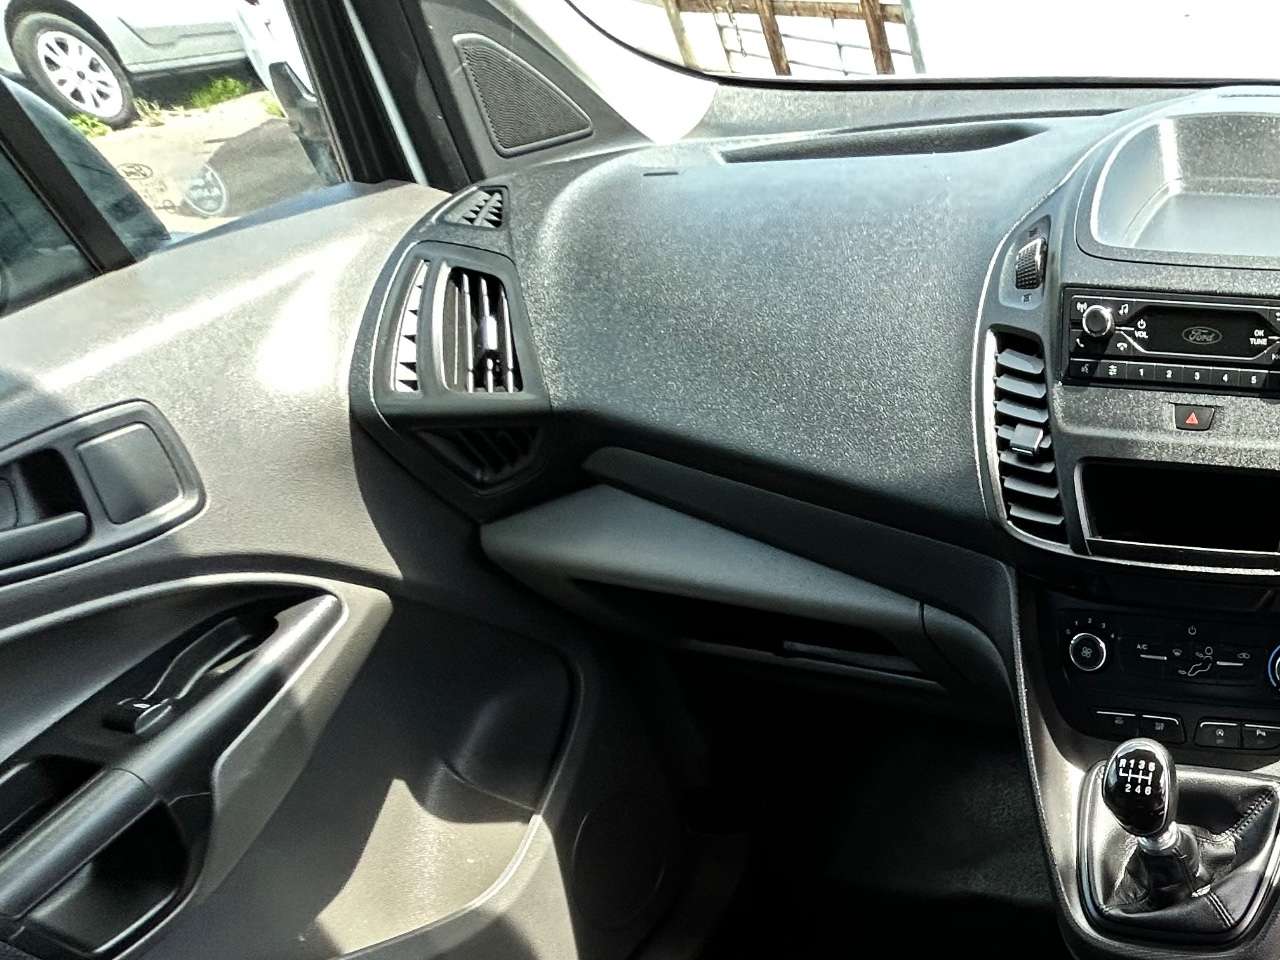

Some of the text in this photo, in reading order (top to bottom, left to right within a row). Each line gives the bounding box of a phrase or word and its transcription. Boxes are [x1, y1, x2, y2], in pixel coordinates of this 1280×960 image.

[1134, 330, 1149, 339] VOL
[1188, 328, 1216, 342] Ford
[1253, 329, 1265, 337] OK
[1249, 337, 1268, 345] TUNE
[1166, 369, 1172, 379] 2
[1194, 371, 1200, 381] 3
[1222, 373, 1228, 383] 4
[1251, 375, 1257, 384] 5
[1119, 758, 1156, 772] R 1 3 5
[1125, 783, 1152, 796] 2 4 6
